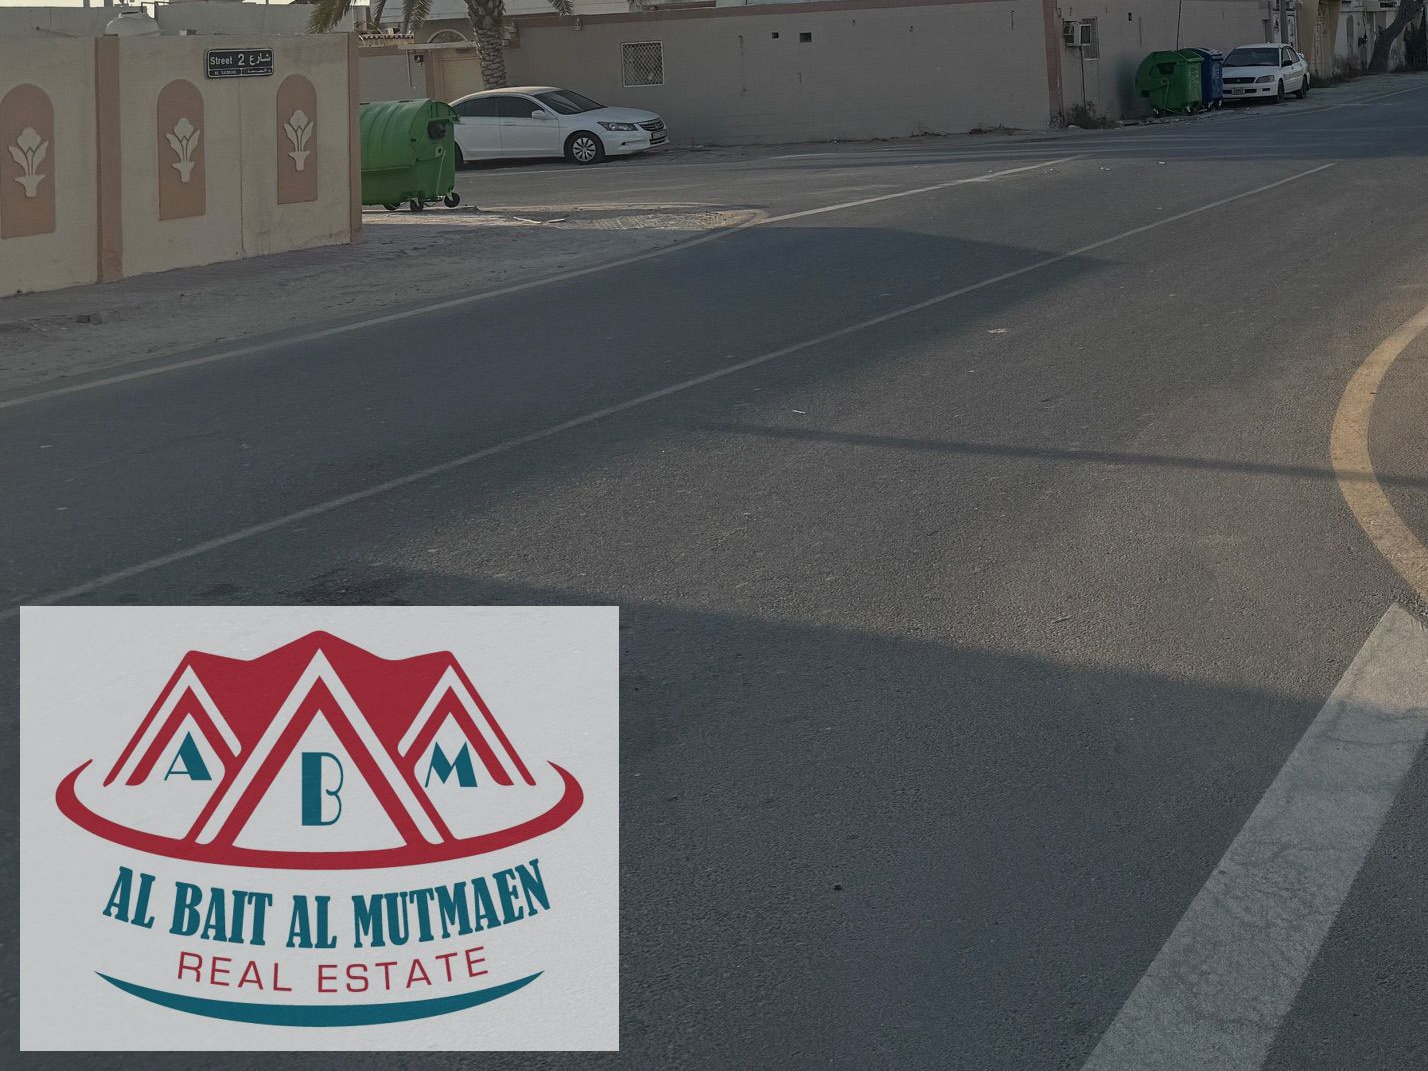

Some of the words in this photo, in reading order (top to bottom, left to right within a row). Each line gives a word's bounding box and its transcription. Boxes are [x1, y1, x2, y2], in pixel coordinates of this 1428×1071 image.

[210, 56, 233, 65] Street
[238, 53, 245, 66] 2
[249, 52, 271, 66] شارع
